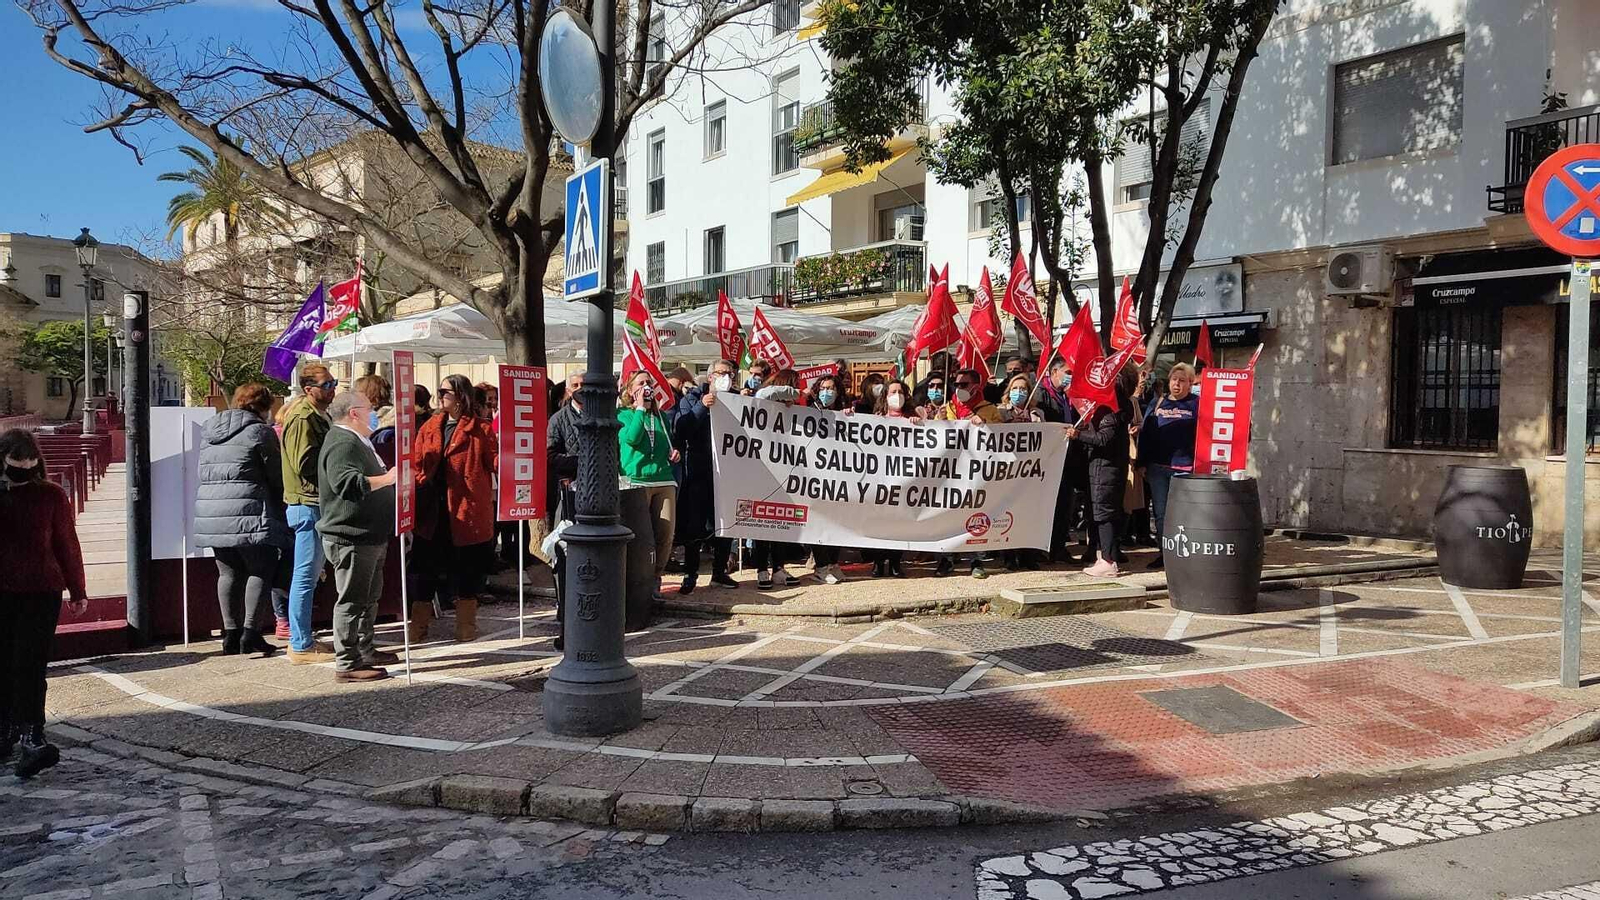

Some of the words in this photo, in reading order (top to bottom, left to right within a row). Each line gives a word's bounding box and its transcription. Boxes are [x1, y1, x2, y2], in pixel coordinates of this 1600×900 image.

[1432, 287, 1476, 298] Cruzcampo
[1214, 328, 1246, 338] Cruzcampo
[503, 369, 542, 380] SANIDAD
[1206, 371, 1249, 380] SANIDAD
[1210, 379, 1238, 463] CCOO
[513, 379, 534, 481] CCOO
[740, 405, 768, 431] NO
[772, 412, 785, 434] A
[791, 414, 829, 440] LOS
[835, 420, 937, 449] RECORTES
[945, 429, 970, 450] EN
[976, 430, 1043, 453] FAISEM
[722, 433, 763, 460] POR
[769, 441, 808, 468] UNA
[815, 447, 879, 475] SALUD
[885, 455, 962, 480] MENTAL
[969, 455, 1046, 482] PÚBLICA,
[786, 474, 849, 503] DIGNA
[857, 482, 870, 503] Y
[875, 484, 901, 506] DE
[906, 485, 987, 509] CALIDAD
[509, 507, 537, 517] CÁDIZ
[756, 505, 794, 518] CCOO
[1476, 526, 1506, 539] TIO
[1191, 541, 1236, 556] PEPE
